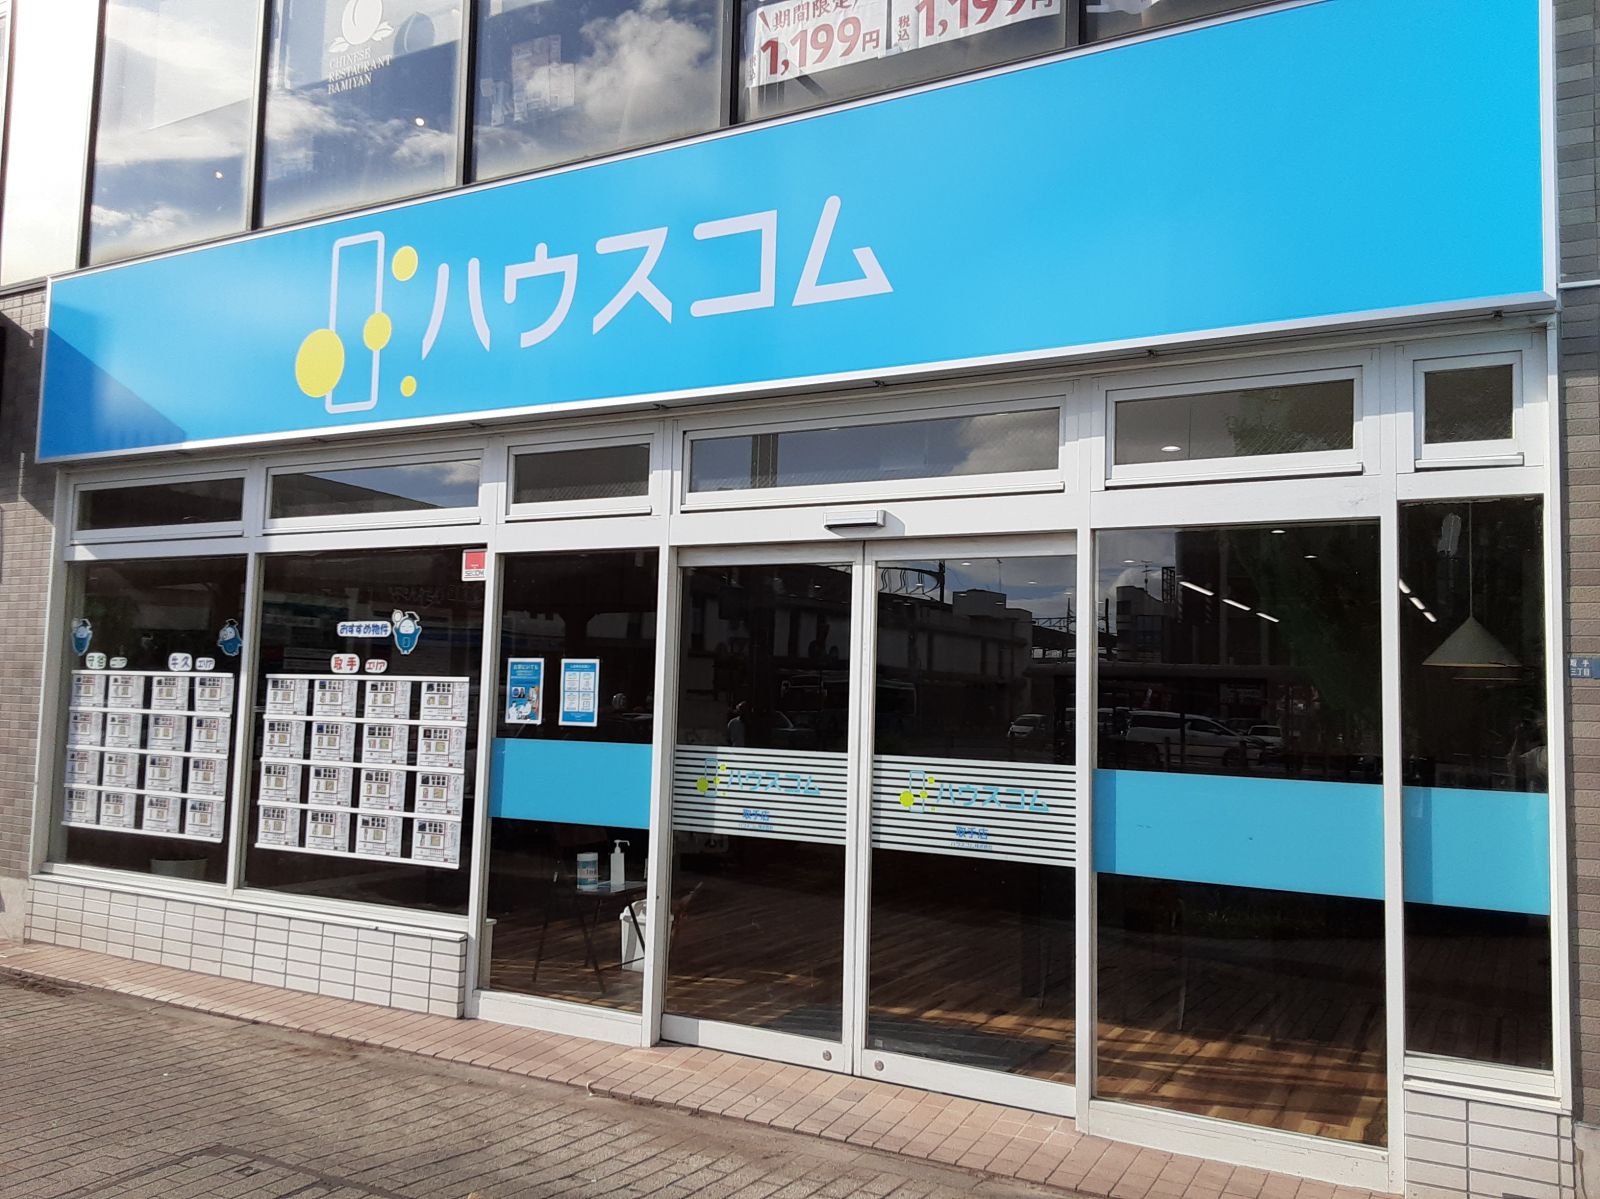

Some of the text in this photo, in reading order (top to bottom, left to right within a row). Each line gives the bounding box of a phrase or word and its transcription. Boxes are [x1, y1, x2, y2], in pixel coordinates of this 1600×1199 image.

[329, 47, 371, 70] CHINESE
[760, 16, 881, 76] 1,199円
[328, 54, 393, 83] RESTAURANT
[421, 195, 894, 360] ハウスコム
[339, 623, 389, 635] おすすめ物件
[333, 656, 386, 671] 取手 エリア
[727, 769, 821, 796] ハウスコム
[936, 783, 1050, 812] ハウスコム
[955, 825, 989, 840] 取手店
